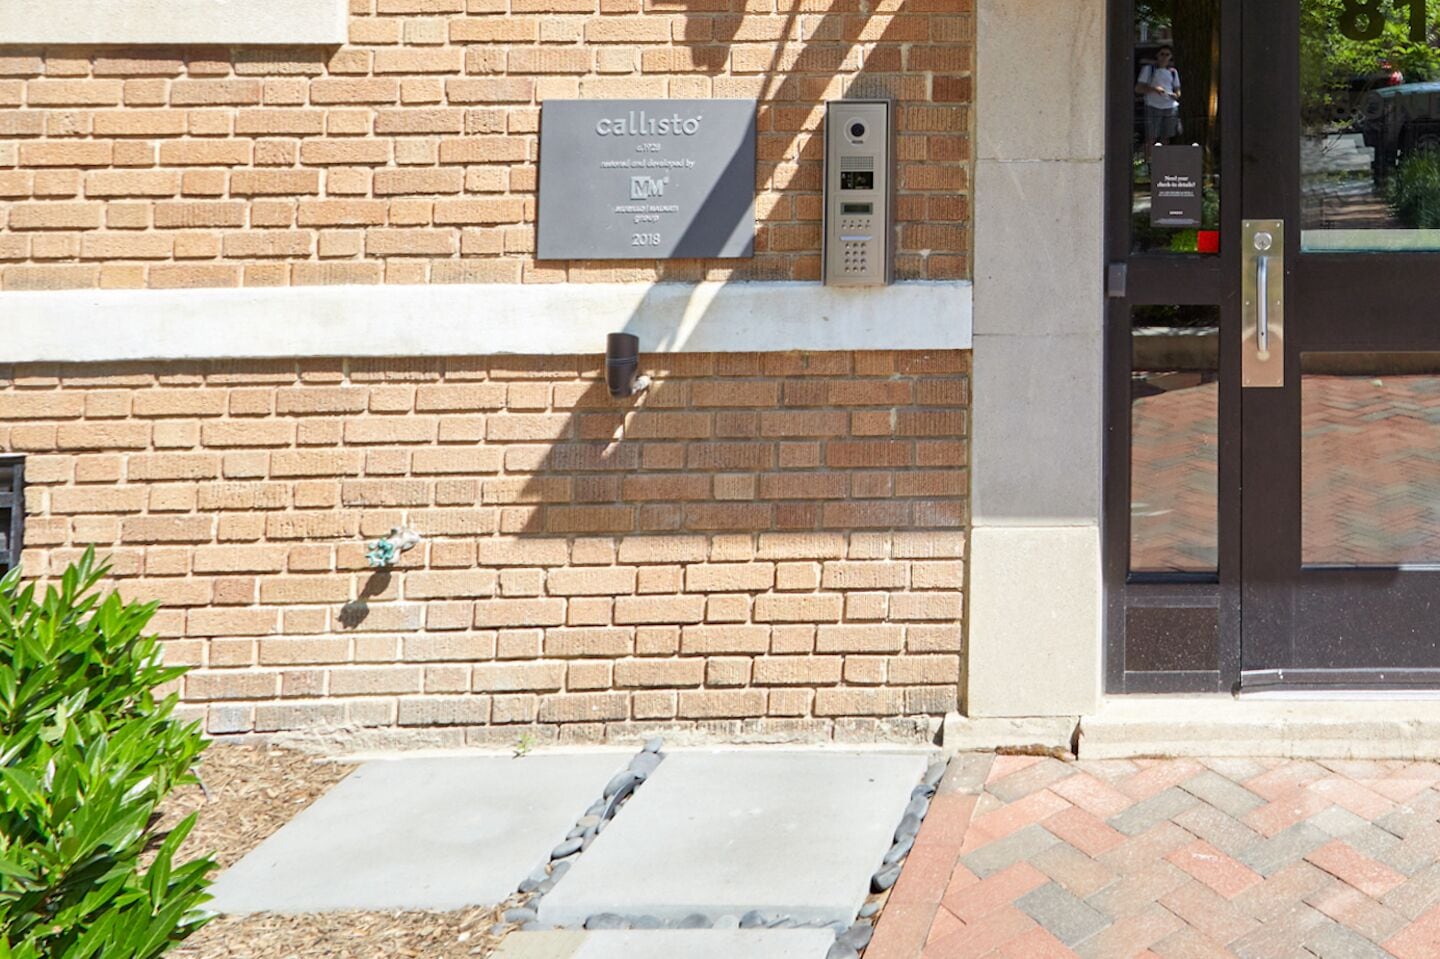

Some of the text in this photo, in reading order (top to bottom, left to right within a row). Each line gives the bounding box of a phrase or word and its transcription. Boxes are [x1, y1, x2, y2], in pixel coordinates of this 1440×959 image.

[595, 110, 702, 136] callisto
[685, 158, 696, 169] by
[631, 233, 661, 246] 2018
